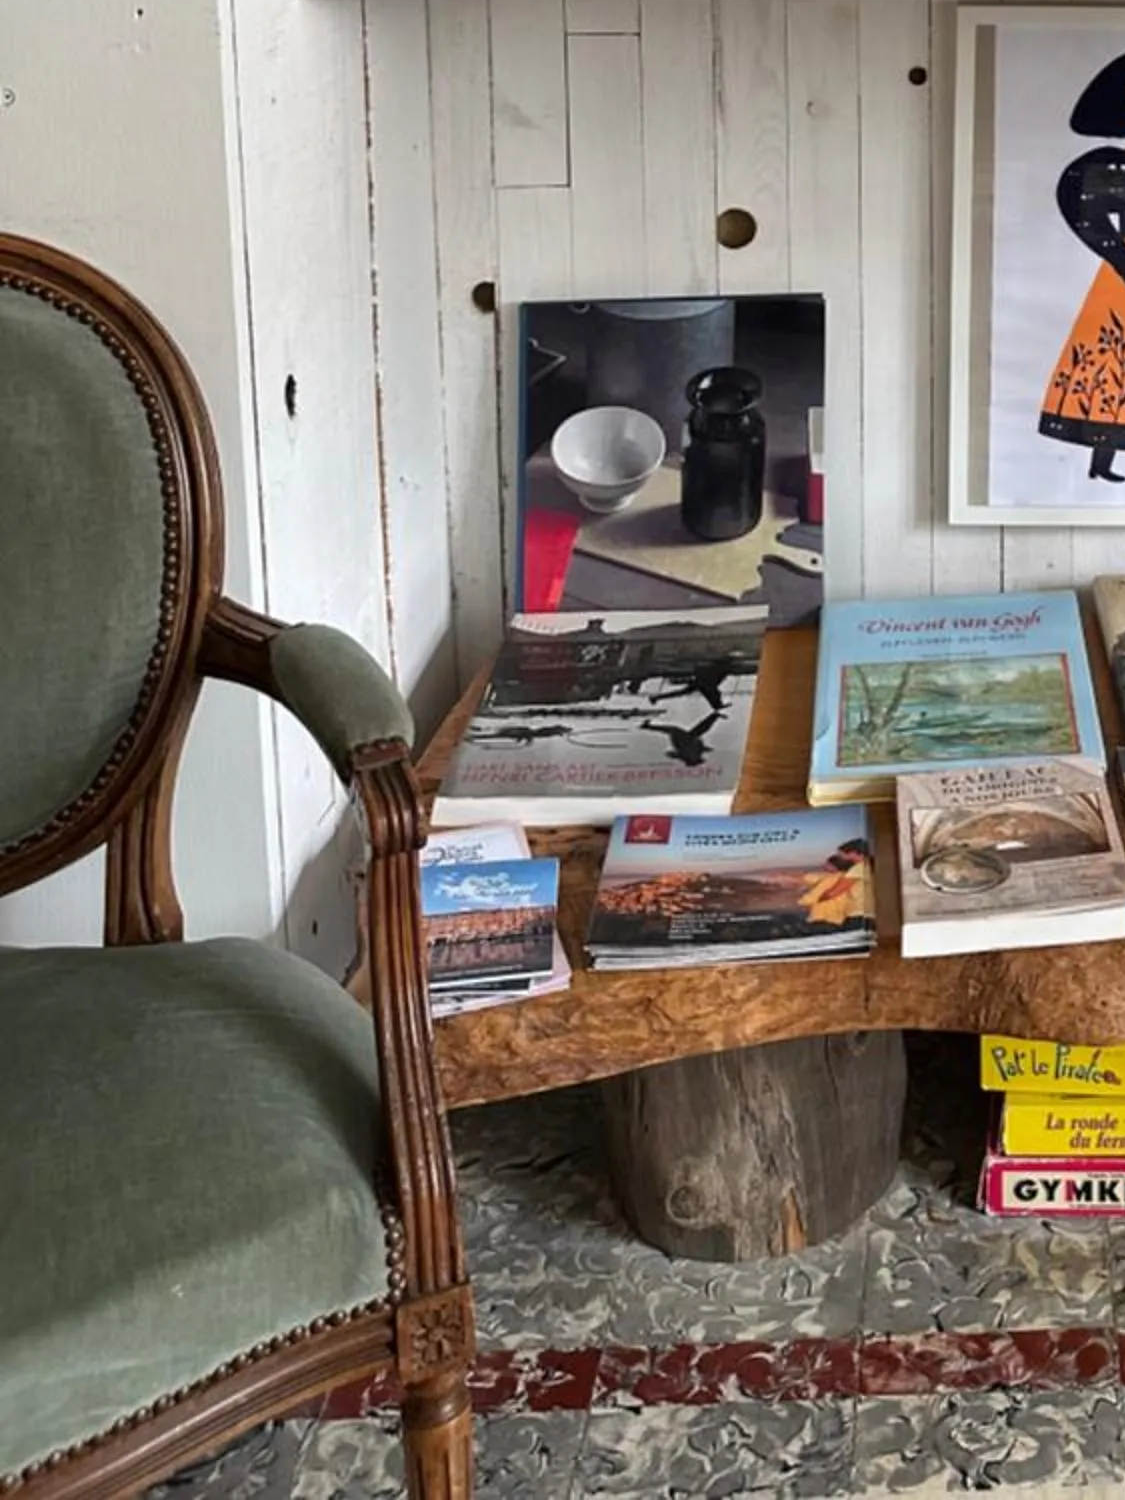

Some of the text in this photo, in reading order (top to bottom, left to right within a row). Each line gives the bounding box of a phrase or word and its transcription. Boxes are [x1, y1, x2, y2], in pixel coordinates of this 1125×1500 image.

[858, 613, 946, 636] Vincent
[1046, 1112, 1119, 1130] La ronde
[1069, 1131, 1092, 1149] du
